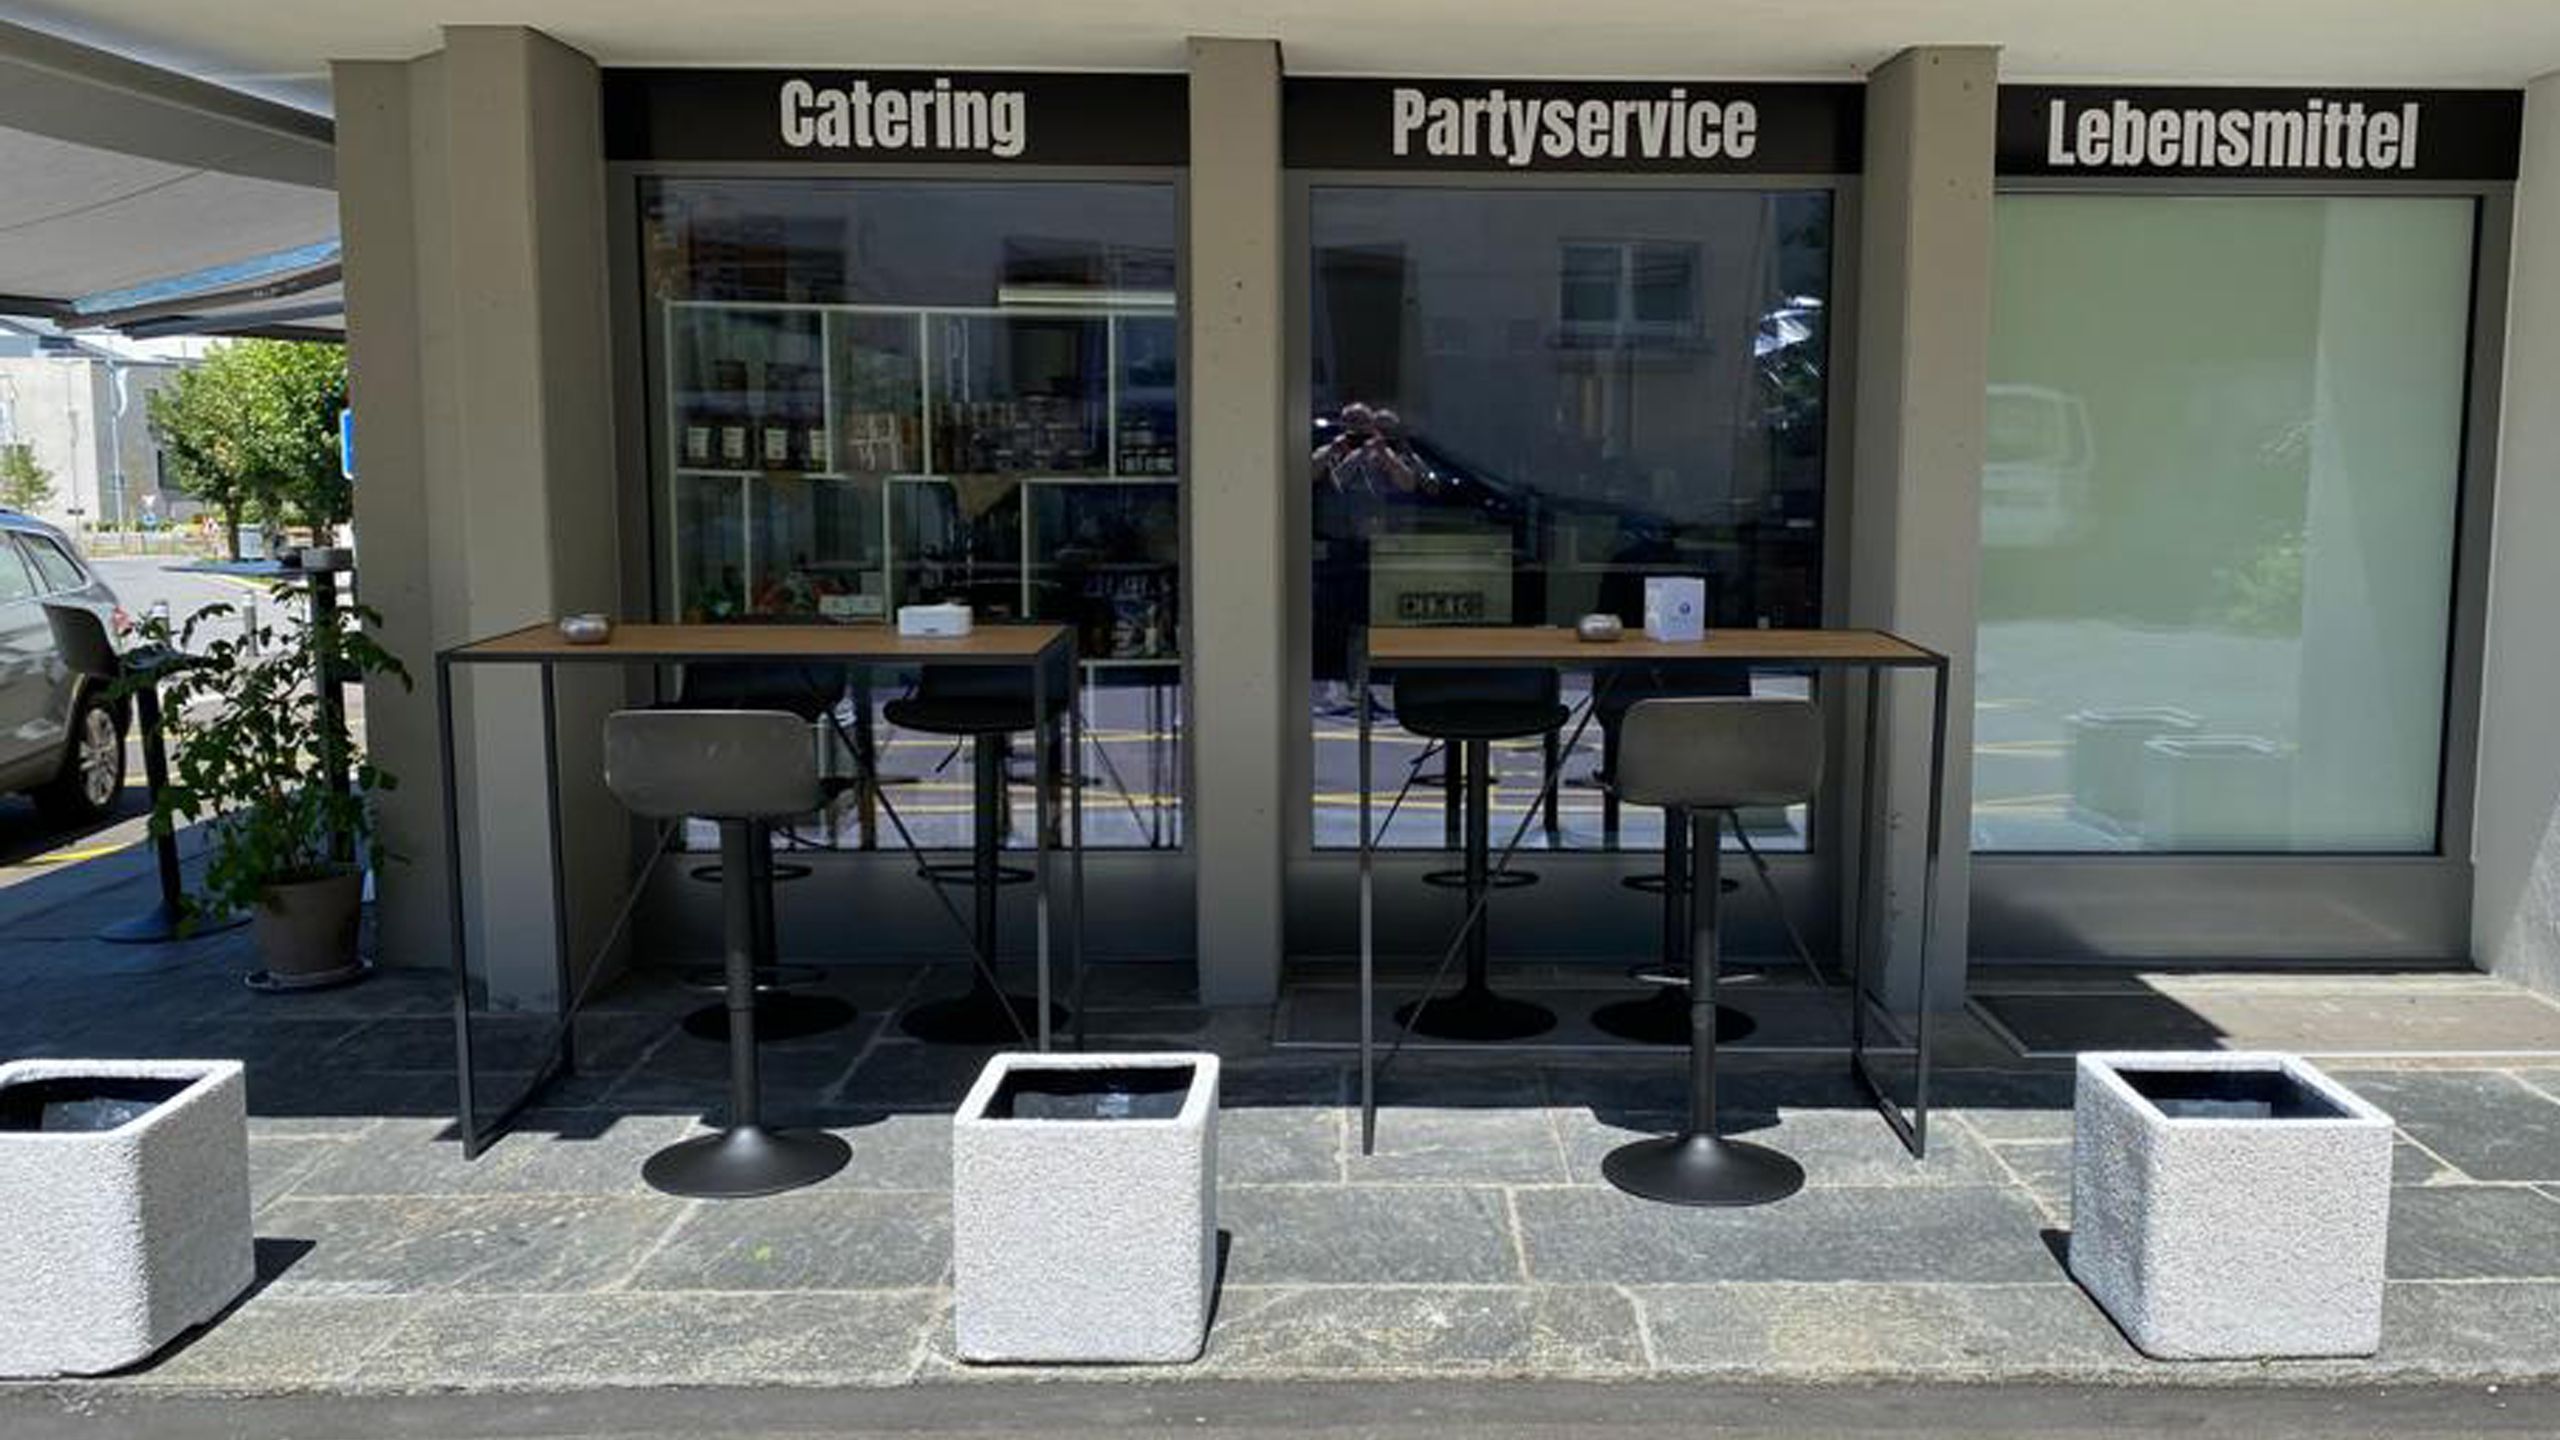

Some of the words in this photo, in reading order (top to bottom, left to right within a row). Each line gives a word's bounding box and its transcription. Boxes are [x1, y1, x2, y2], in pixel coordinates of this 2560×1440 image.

[780, 78, 1025, 157] Catering
[1393, 88, 1757, 166] Partyservice
[2048, 99, 2419, 169] Lebensmittel
